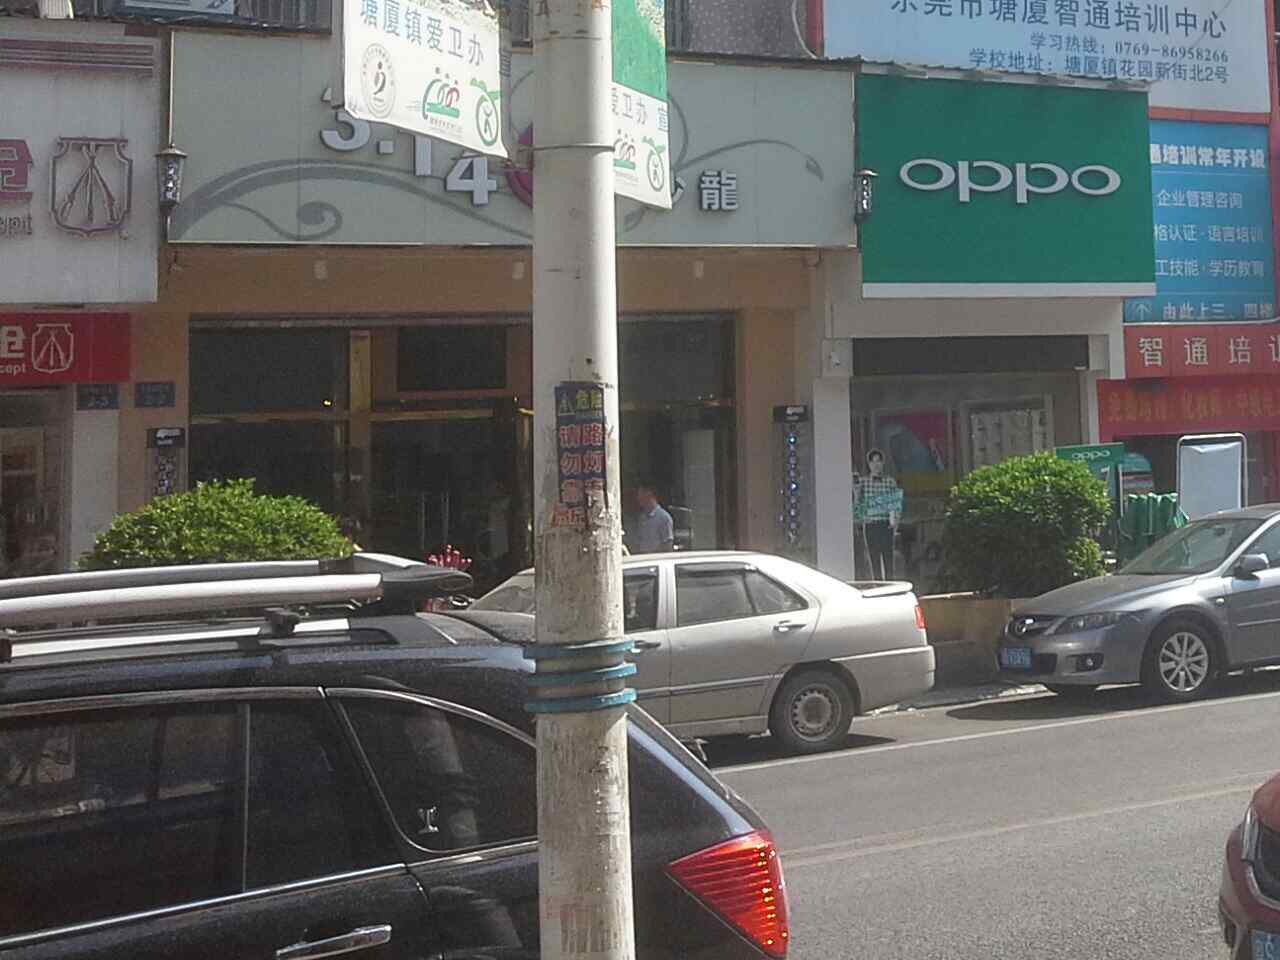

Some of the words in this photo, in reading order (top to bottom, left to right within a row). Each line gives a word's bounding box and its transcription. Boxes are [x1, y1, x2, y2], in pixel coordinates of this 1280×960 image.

[1157, 189, 1244, 210] 企业管理咨询
